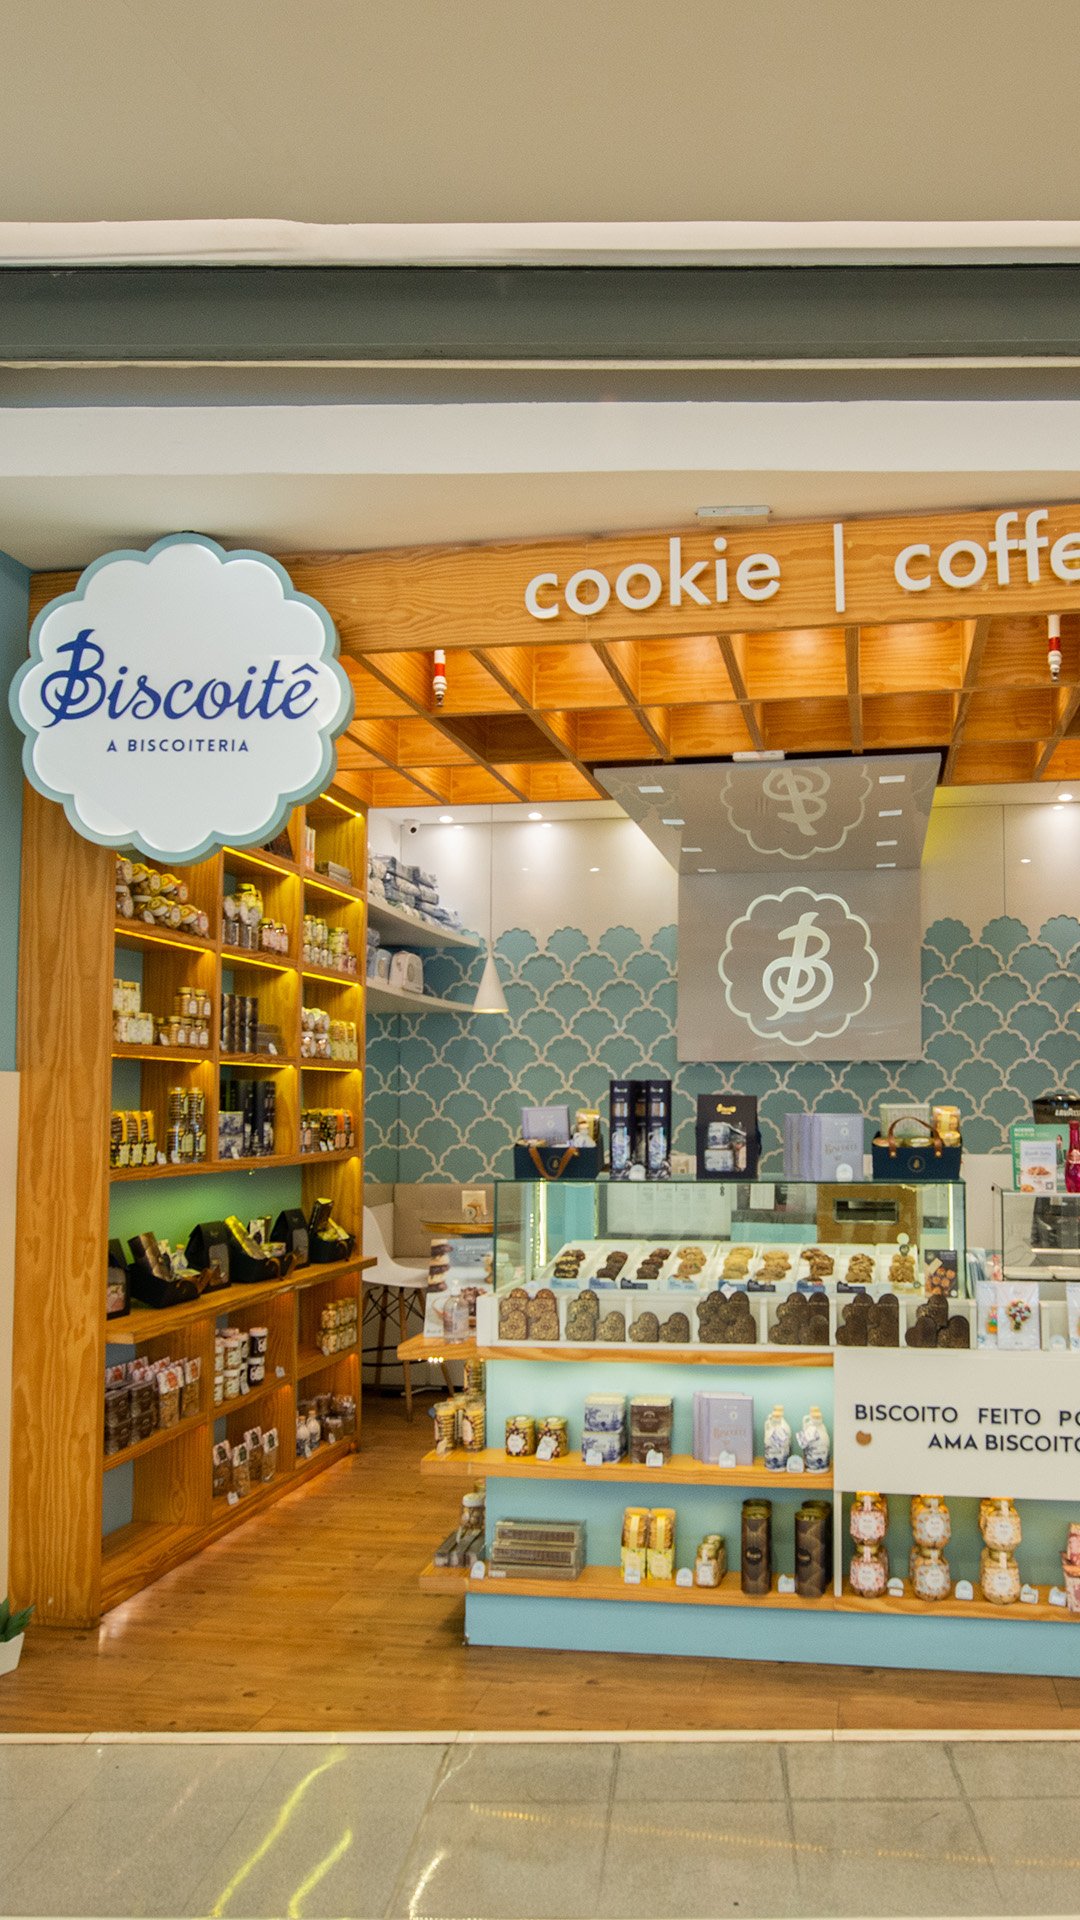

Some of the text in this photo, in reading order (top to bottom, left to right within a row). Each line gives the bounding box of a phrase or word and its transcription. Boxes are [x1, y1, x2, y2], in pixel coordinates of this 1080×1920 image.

[525, 509, 1080, 619] cookie coffe
[40, 628, 319, 728] Biscoitê
[106, 739, 249, 752] A BISCOITERIA
[855, 1404, 958, 1423] BISCOITO
[978, 1408, 1041, 1425] FEITO
[928, 1433, 978, 1450] AMA
